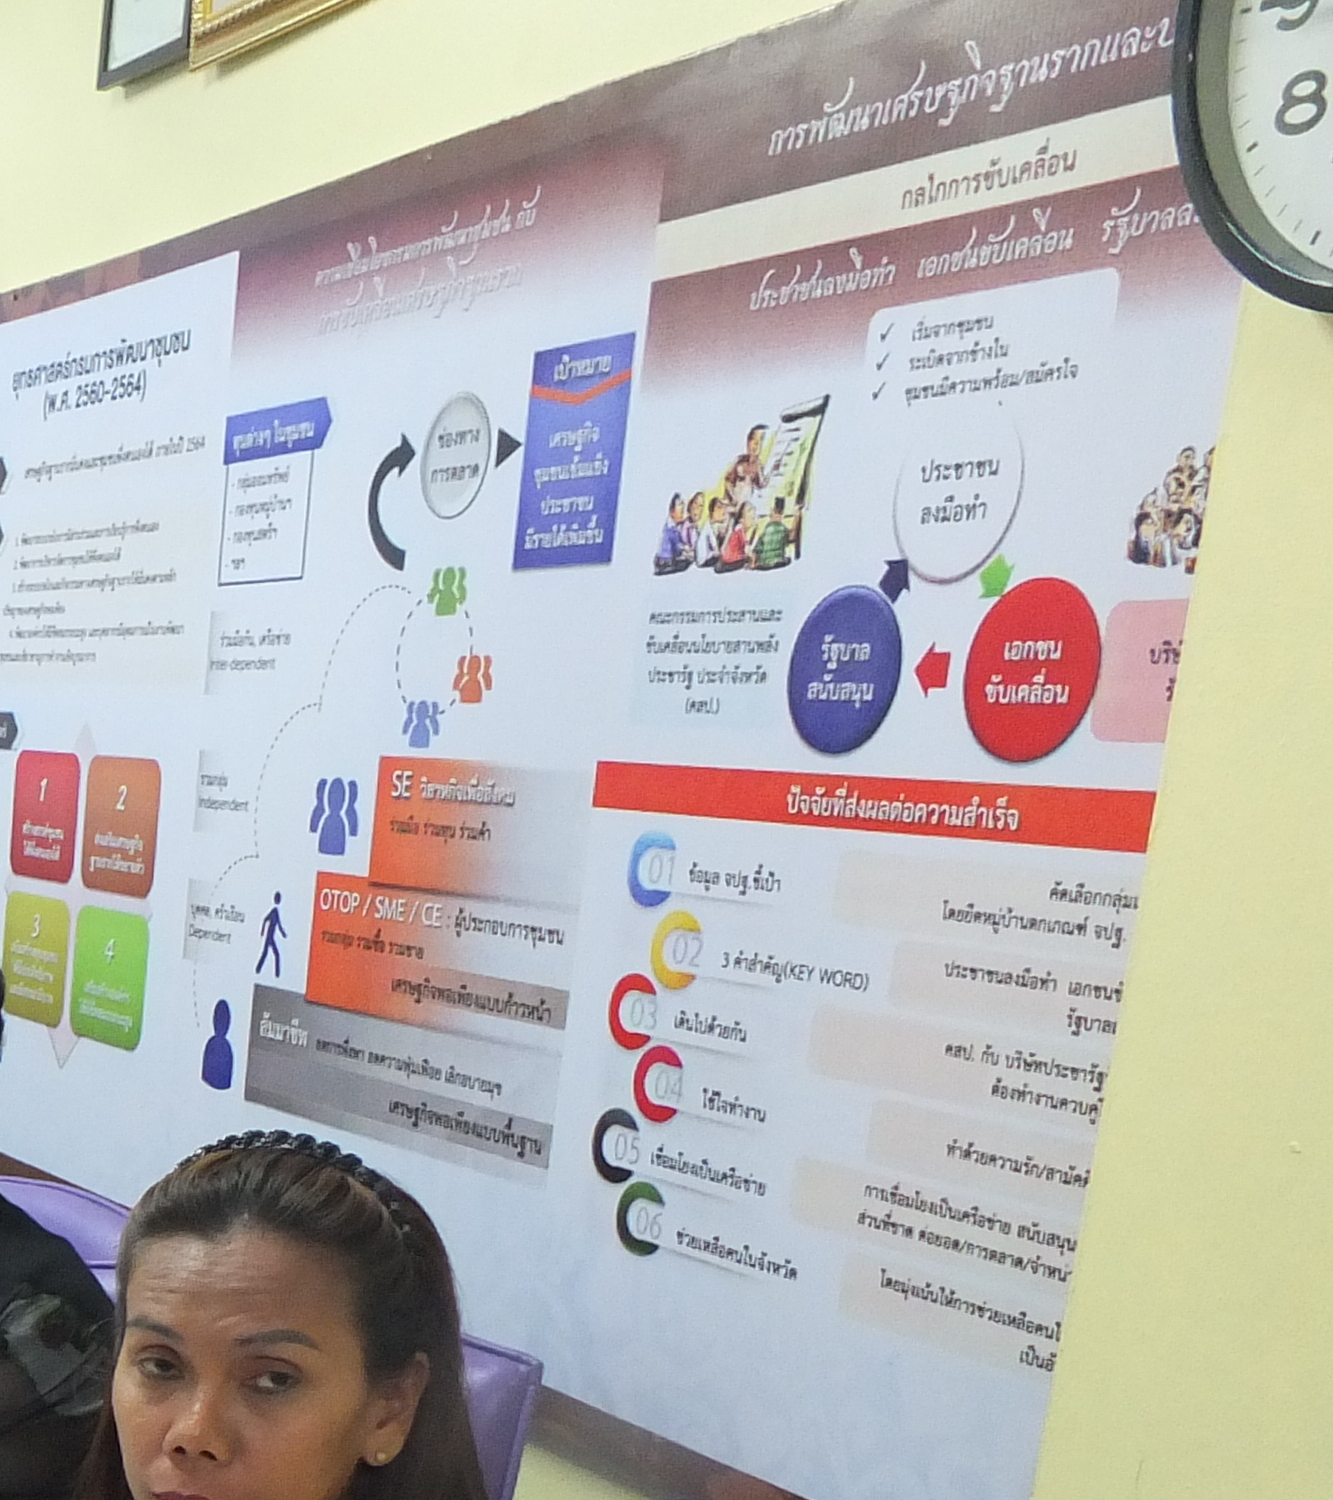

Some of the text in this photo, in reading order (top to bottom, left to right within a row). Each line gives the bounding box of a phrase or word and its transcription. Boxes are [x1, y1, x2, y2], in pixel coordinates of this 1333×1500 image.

[1274, 69, 1327, 136] 8
[900, 141, 1078, 210] กลไกการขับเคลื่อน
[437, 425, 481, 449] ช่องทาง
[921, 458, 1001, 484] ประชาชน
[920, 493, 988, 525] ลงมือทำ
[820, 633, 873, 671] รัฐบาล
[1003, 639, 1064, 662] เอกชน
[806, 674, 876, 708] สนับสนุน
[984, 668, 1071, 705] ขับเคลื่อน
[38, 777, 49, 802] 1
[115, 784, 129, 811] 2
[390, 769, 414, 798] SE
[786, 781, 1021, 831] ปัจจัยที่ส่งผลต่อความสำเร็จ
[648, 853, 676, 885] 01
[319, 888, 361, 914] OTOP
[374, 895, 407, 922] SME
[421, 903, 443, 928] CE
[30, 914, 42, 938] 3
[103, 938, 117, 965] 4
[672, 936, 704, 968] 02
[720, 951, 731, 969] 3
[630, 997, 658, 1031] 03
[980, 1044, 1000, 1066] กับ
[654, 1068, 684, 1103] 04
[614, 1132, 641, 1166] 05
[635, 1206, 663, 1240] 06
